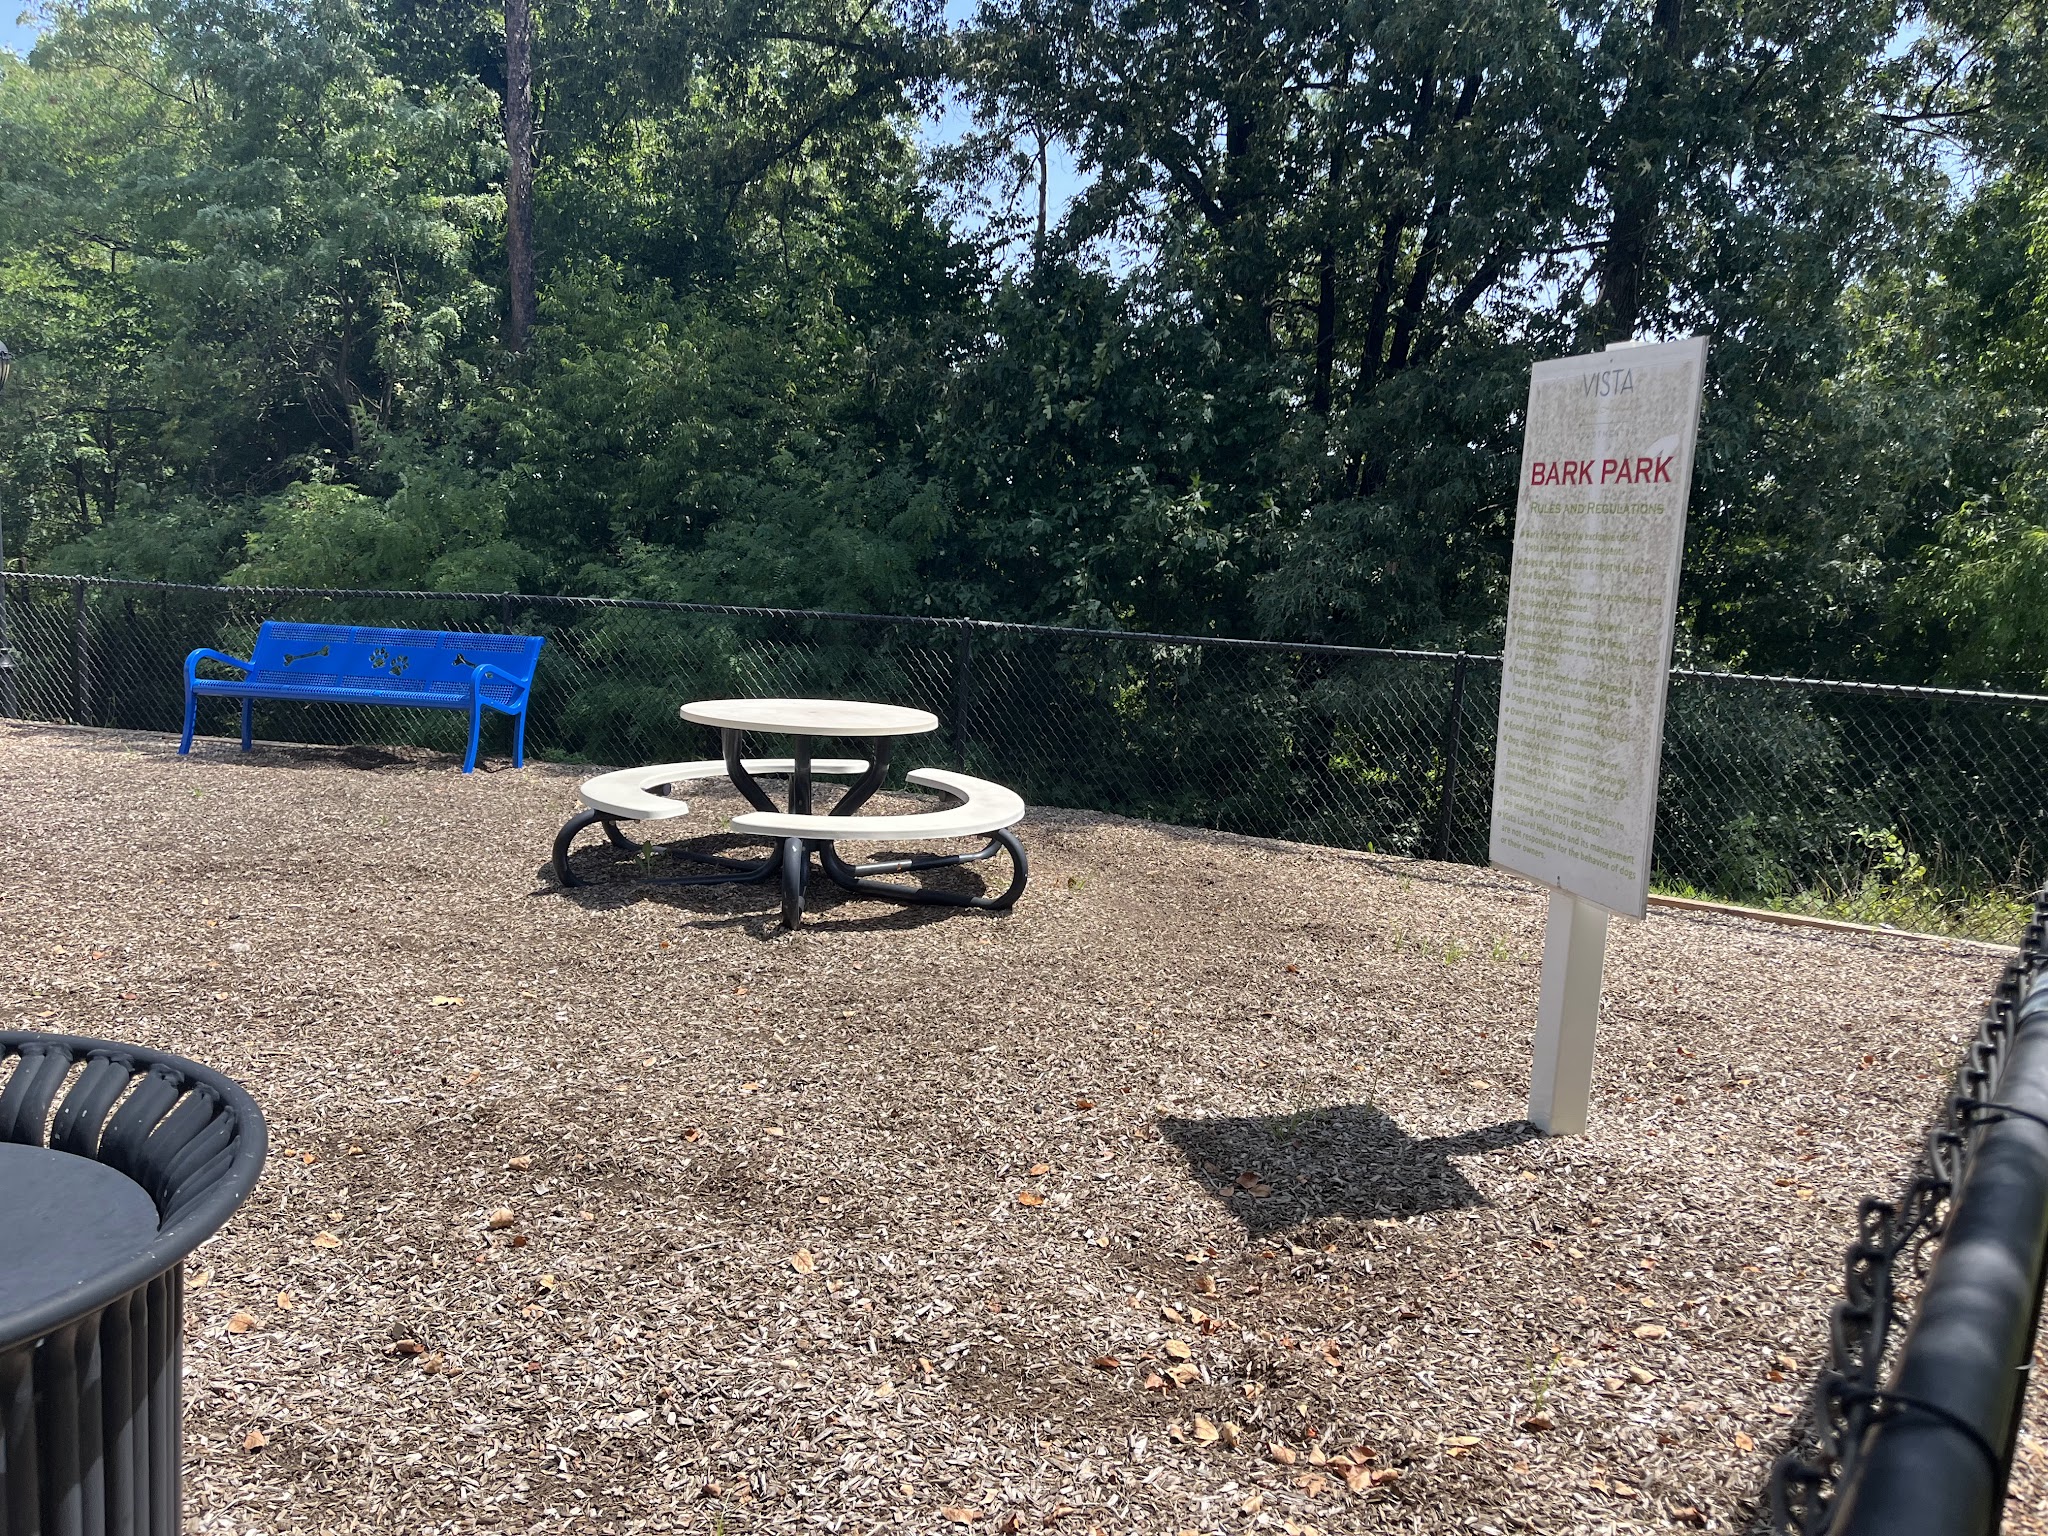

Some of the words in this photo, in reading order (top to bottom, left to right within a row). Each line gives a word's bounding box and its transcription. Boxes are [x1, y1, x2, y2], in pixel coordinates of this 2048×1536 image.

[1583, 368, 1634, 398] VISTA
[1531, 460, 1595, 486] BARK
[1600, 456, 1674, 484] PARK
[1530, 502, 1561, 514] RULES
[1564, 504, 1584, 514] AND
[1586, 501, 1664, 514] REGULATIONS
[1503, 798, 1512, 808] the
[1513, 801, 1533, 816] leasing
[1534, 808, 1551, 820] office
[1552, 814, 1568, 828] (703)
[1501, 825, 1510, 833] are
[1511, 827, 1521, 837] not
[1522, 831, 1556, 852] responsible
[1557, 844, 1566, 854] for
[1568, 847, 1579, 859] the
[1580, 852, 1609, 870] behavior
[1619, 866, 1636, 881] dogs
[1502, 811, 1516, 823] Vista
[1517, 816, 1535, 830] Laurel
[1536, 823, 1565, 842] Highlands
[1567, 834, 1578, 845] and
[1580, 838, 1588, 848] its
[1589, 841, 1634, 866] management
[1507, 838, 1521, 850] their
